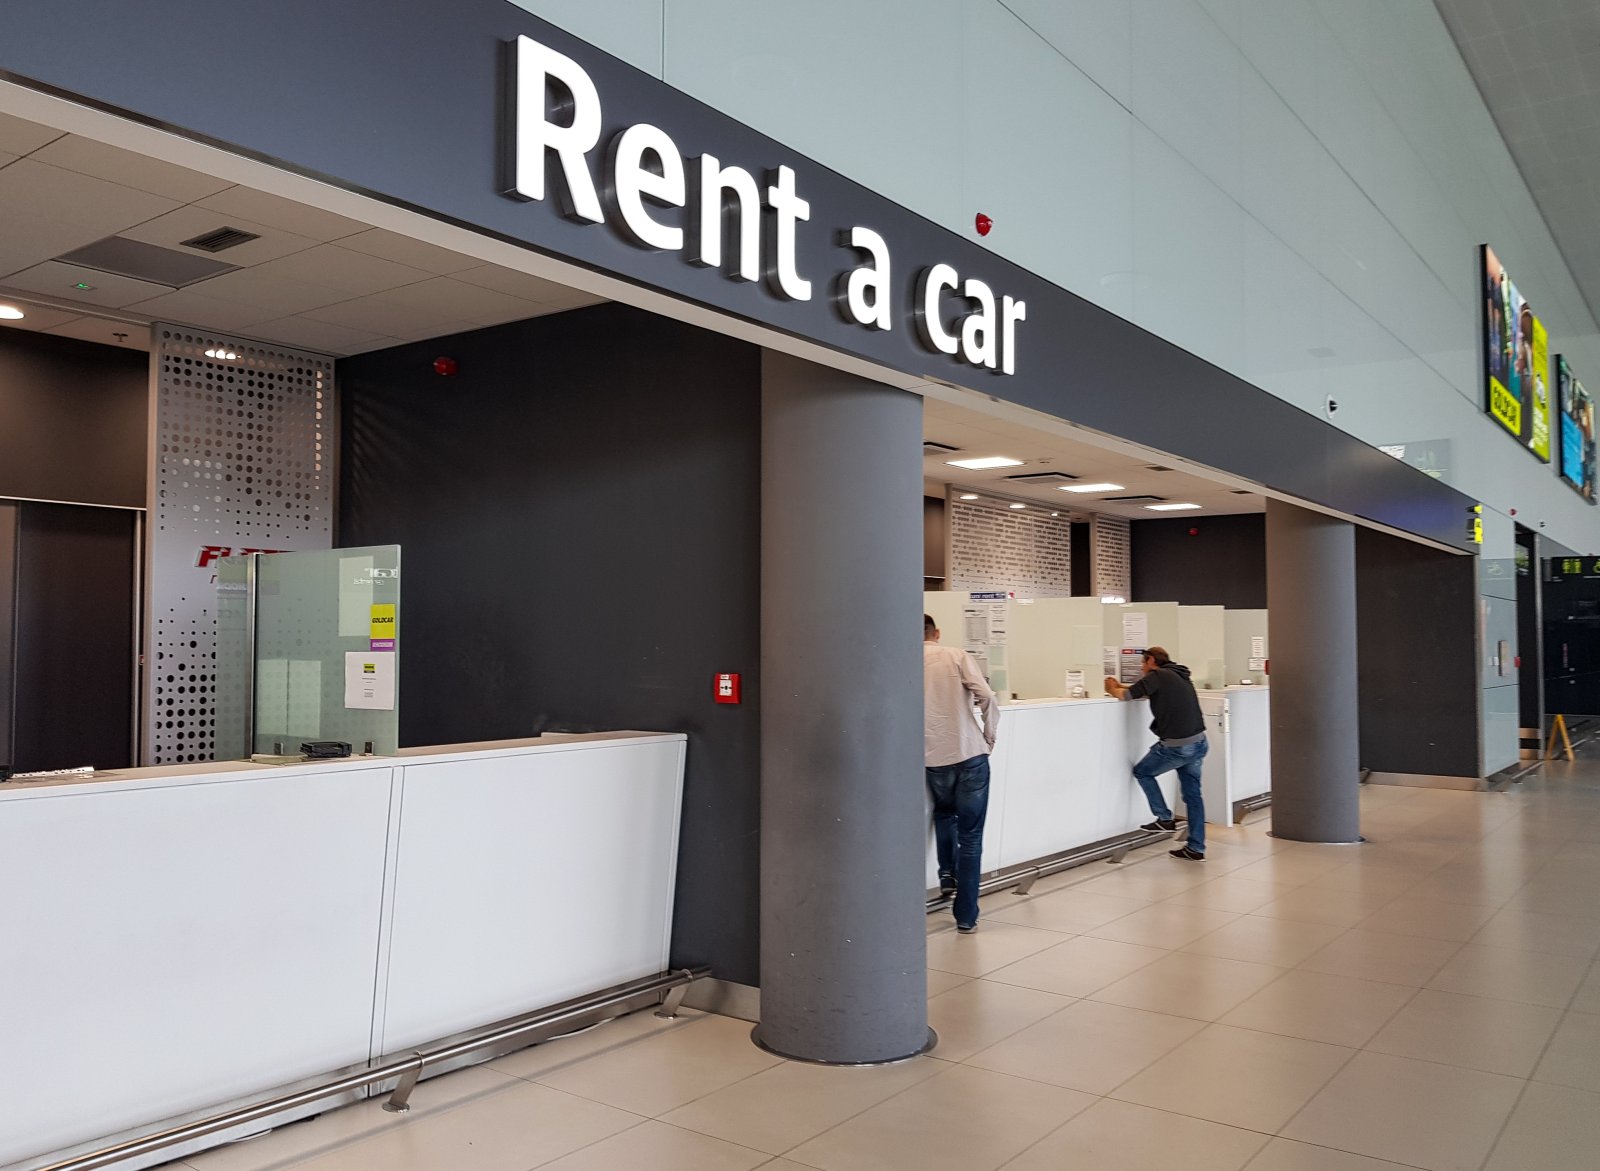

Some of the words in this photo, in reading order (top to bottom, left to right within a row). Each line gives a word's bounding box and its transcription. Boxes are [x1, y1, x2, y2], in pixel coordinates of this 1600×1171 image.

[514, 33, 812, 302] Rent
[845, 225, 892, 332] a
[922, 262, 1027, 376] car
